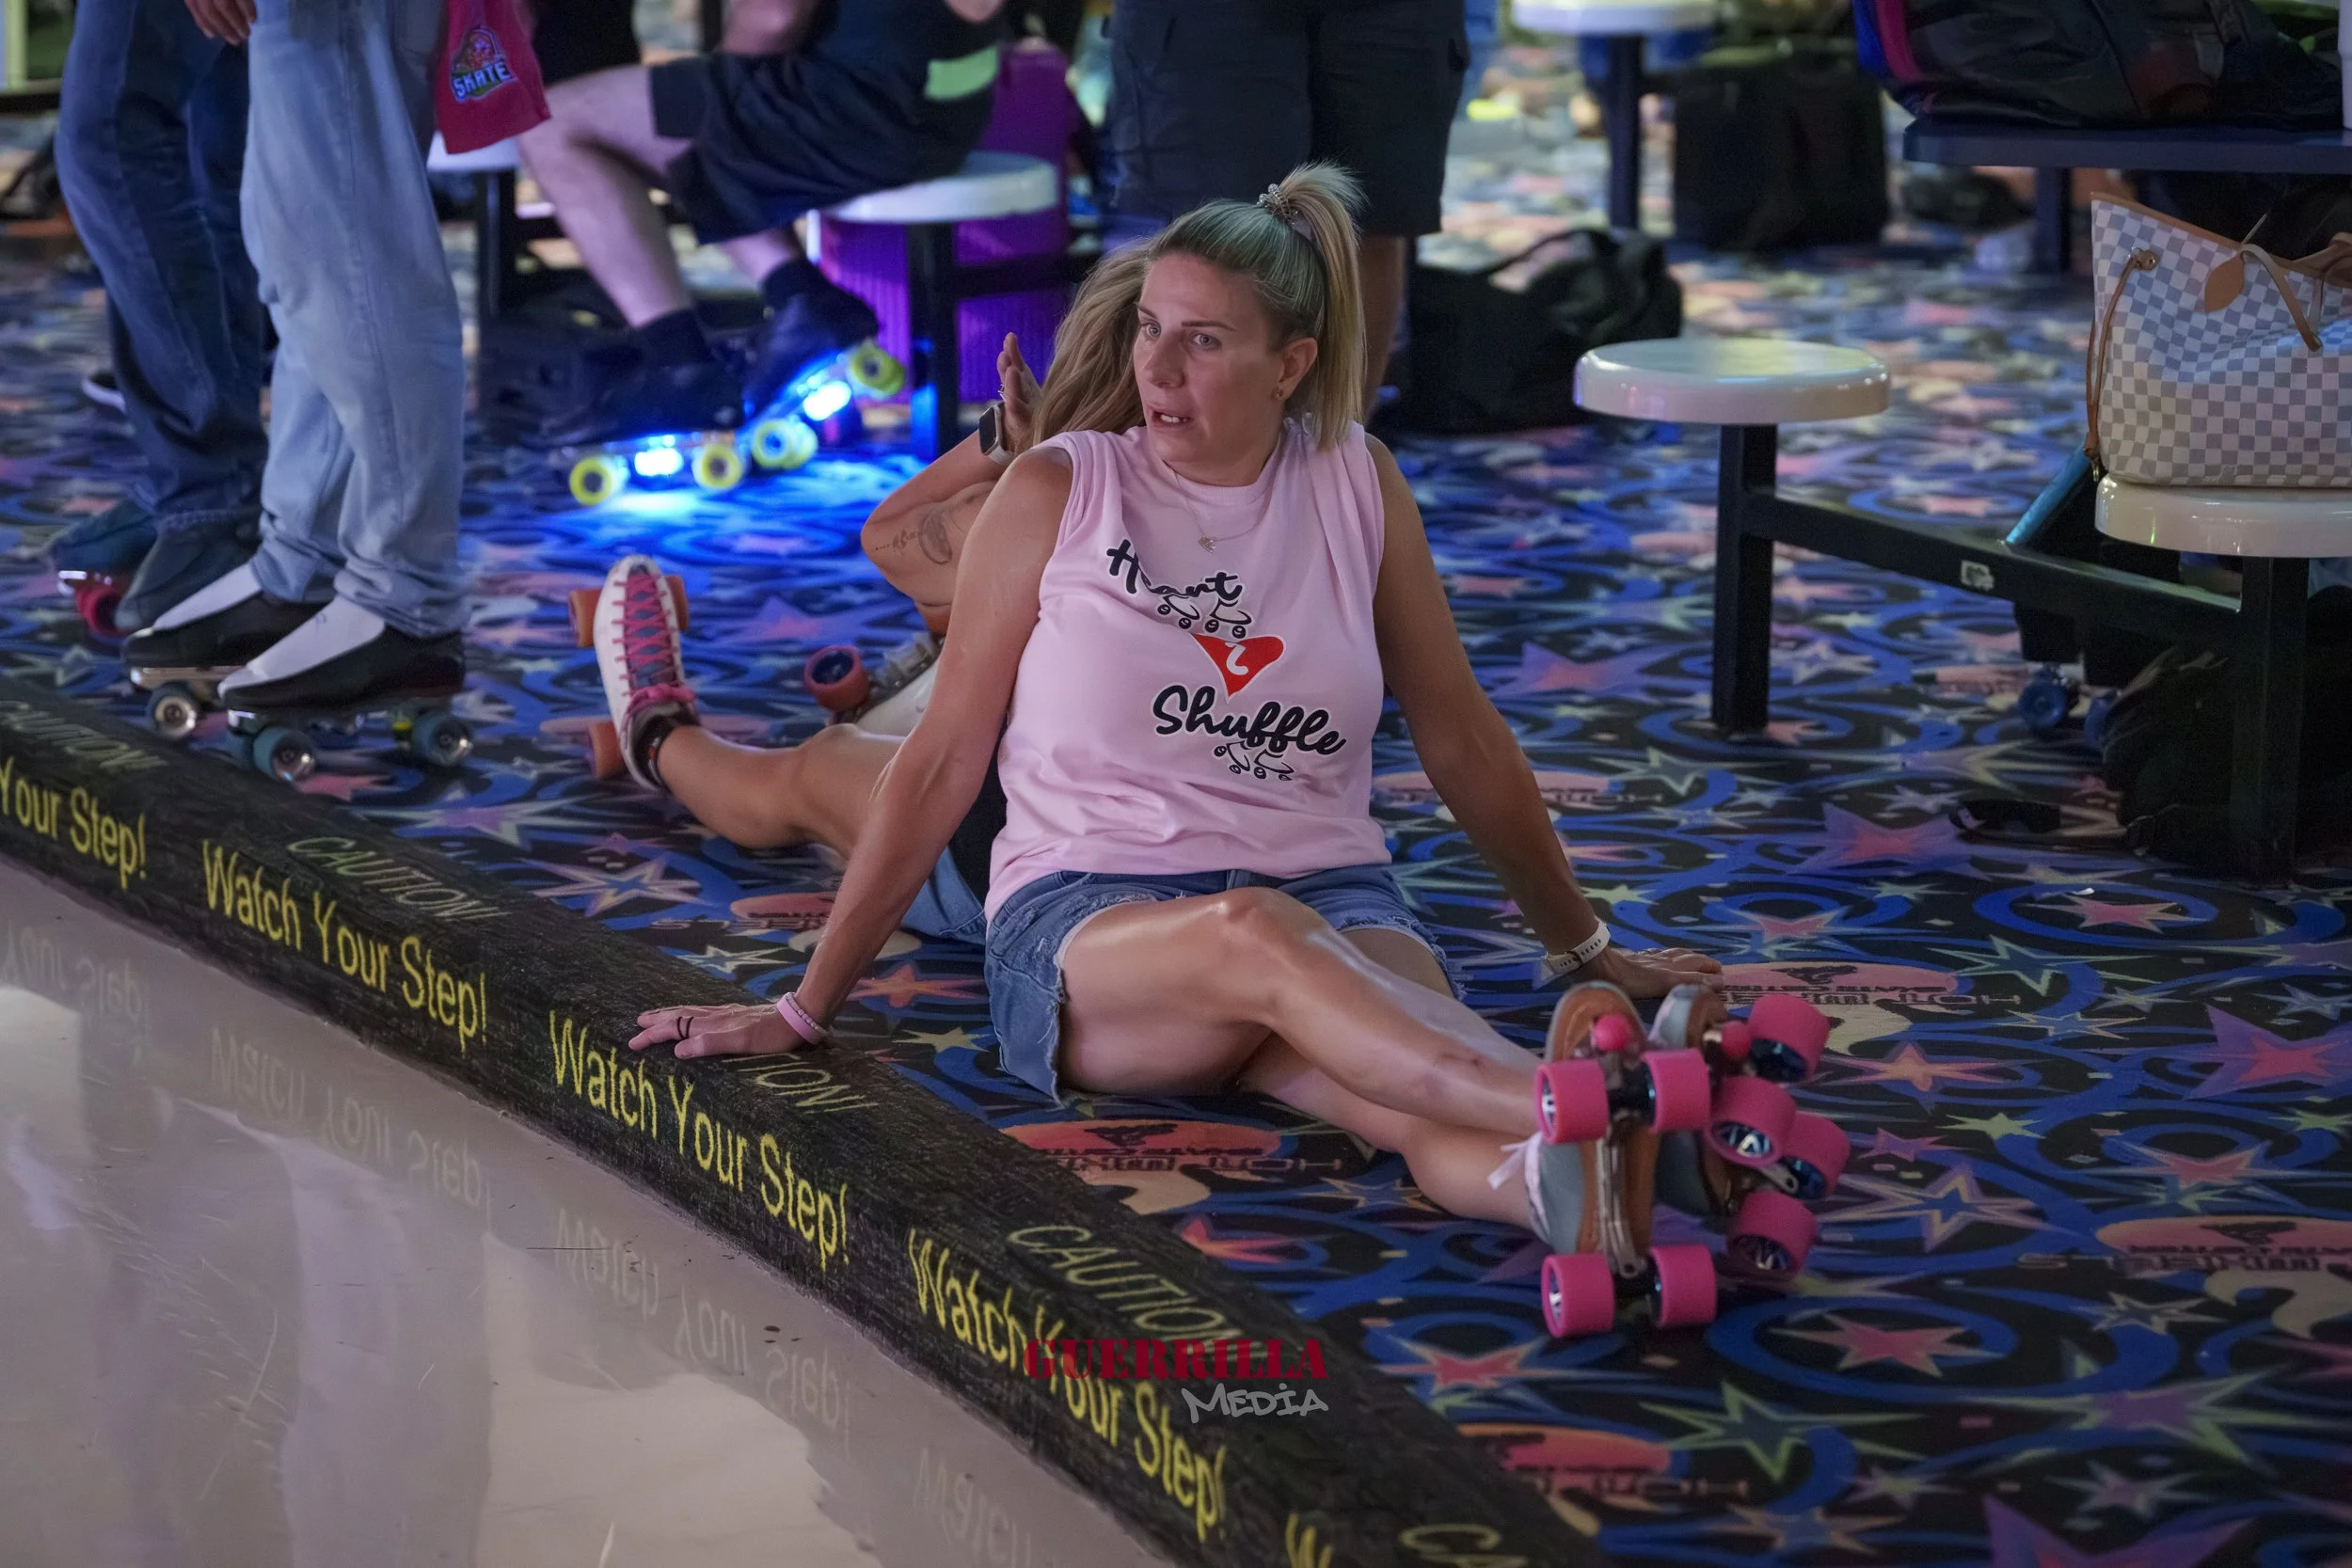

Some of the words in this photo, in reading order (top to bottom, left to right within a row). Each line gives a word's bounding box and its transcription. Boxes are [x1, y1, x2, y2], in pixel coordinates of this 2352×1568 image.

[453, 61, 511, 99] SKATE
[1152, 685, 1347, 755] Shuffle
[0, 755, 60, 842] Your
[71, 786, 147, 891] Step!
[202, 838, 301, 952] Watch
[313, 891, 389, 992] Your
[401, 935, 487, 1058] Step!
[549, 1009, 658, 1139] Watch
[669, 1076, 748, 1192] Your
[760, 1133, 850, 1272] Step!
[722, 1053, 879, 1115] TION!
[909, 1227, 1030, 1376] Watch
[1035, 1304, 1123, 1447] Your
[1135, 1380, 1227, 1544] Step!
